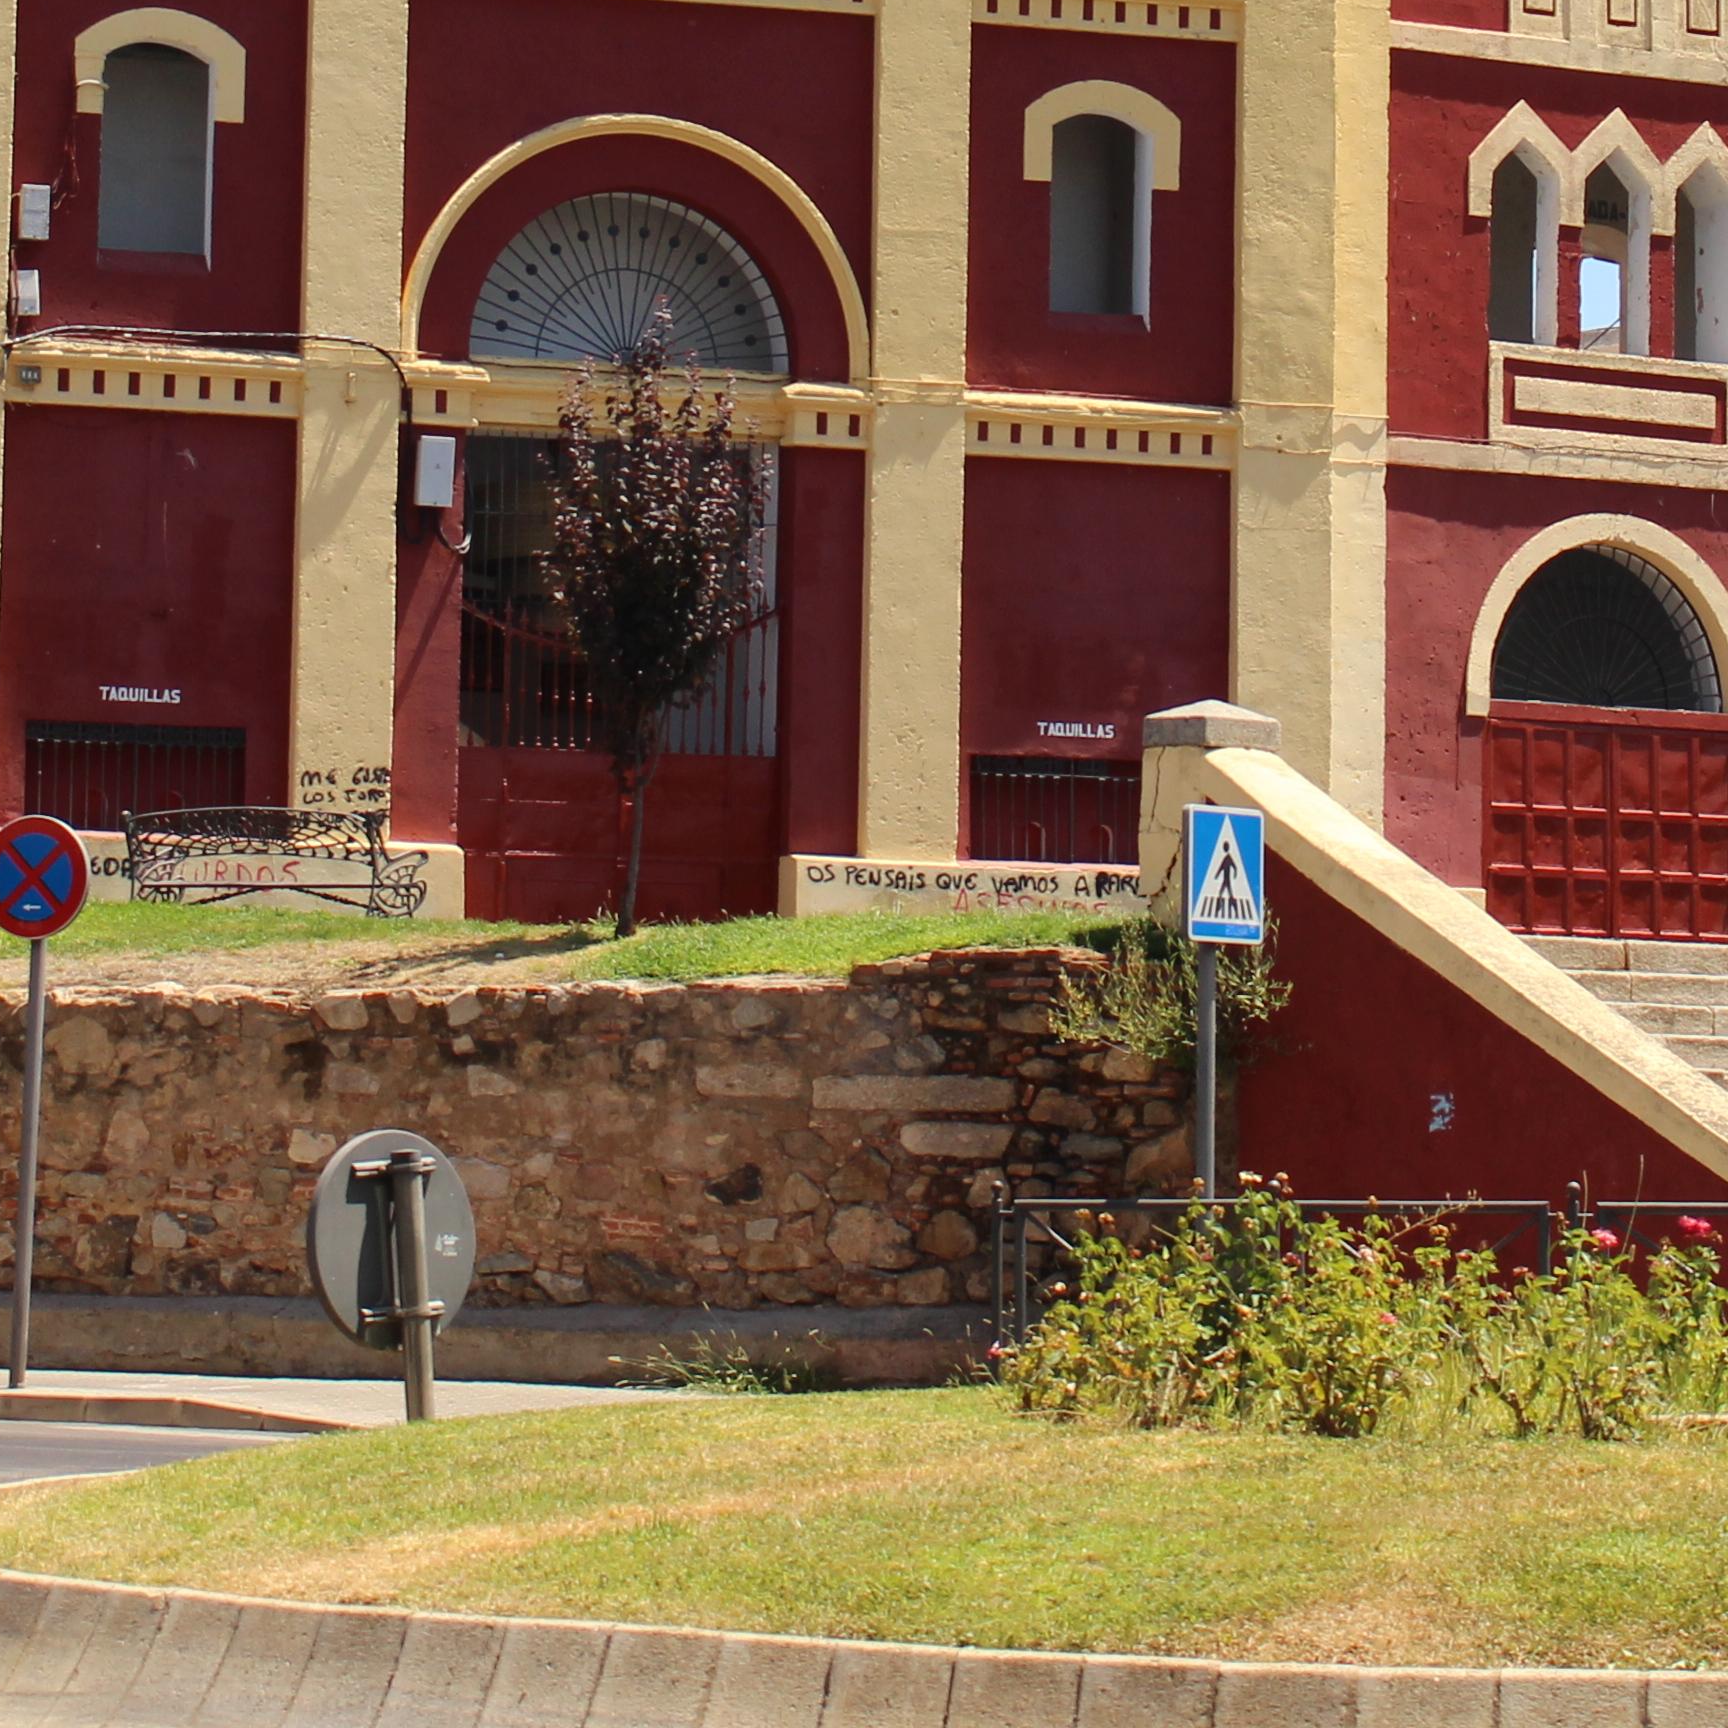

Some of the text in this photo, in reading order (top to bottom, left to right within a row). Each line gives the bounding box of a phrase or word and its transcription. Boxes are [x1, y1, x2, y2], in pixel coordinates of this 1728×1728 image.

[99, 686, 181, 703] TAQUILLAS
[1037, 722, 1114, 739] TAQUILLAS
[806, 864, 835, 883] OS
[991, 875, 1059, 894] VAMOS
[1075, 875, 1090, 897] A
